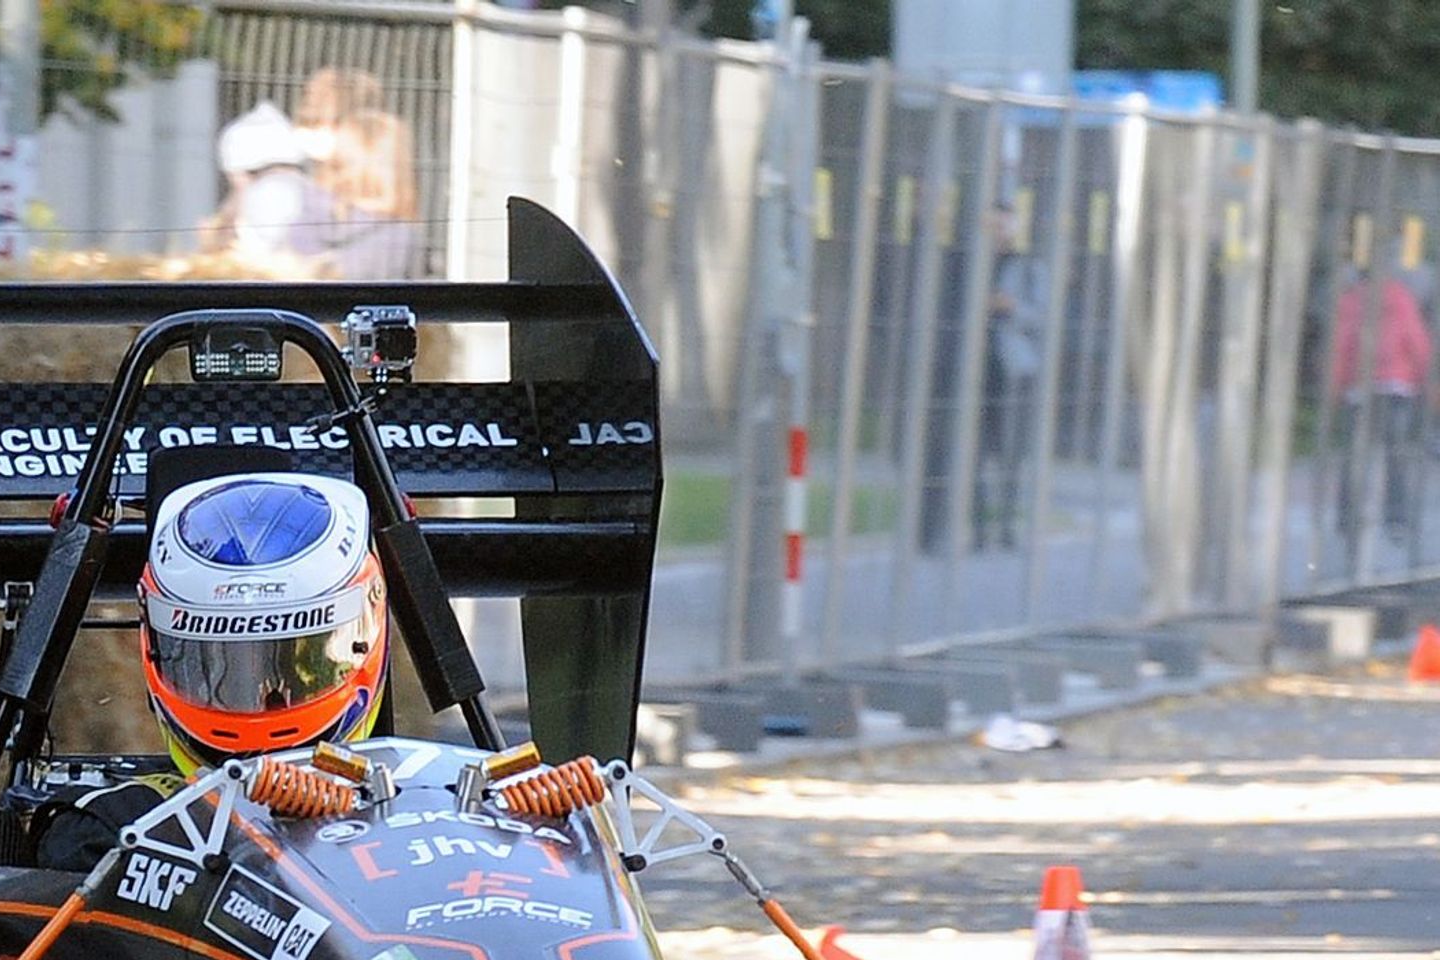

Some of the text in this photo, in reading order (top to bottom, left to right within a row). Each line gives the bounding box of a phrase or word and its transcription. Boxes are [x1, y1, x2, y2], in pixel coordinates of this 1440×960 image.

[231, 423, 518, 450] ELECRICAL
[171, 604, 335, 634] BRIDGESTONE
[407, 836, 512, 866] jhv
[117, 853, 198, 911] SKF
[222, 890, 315, 958] ZEPPELIN CAT
[406, 896, 594, 928] FORCE
